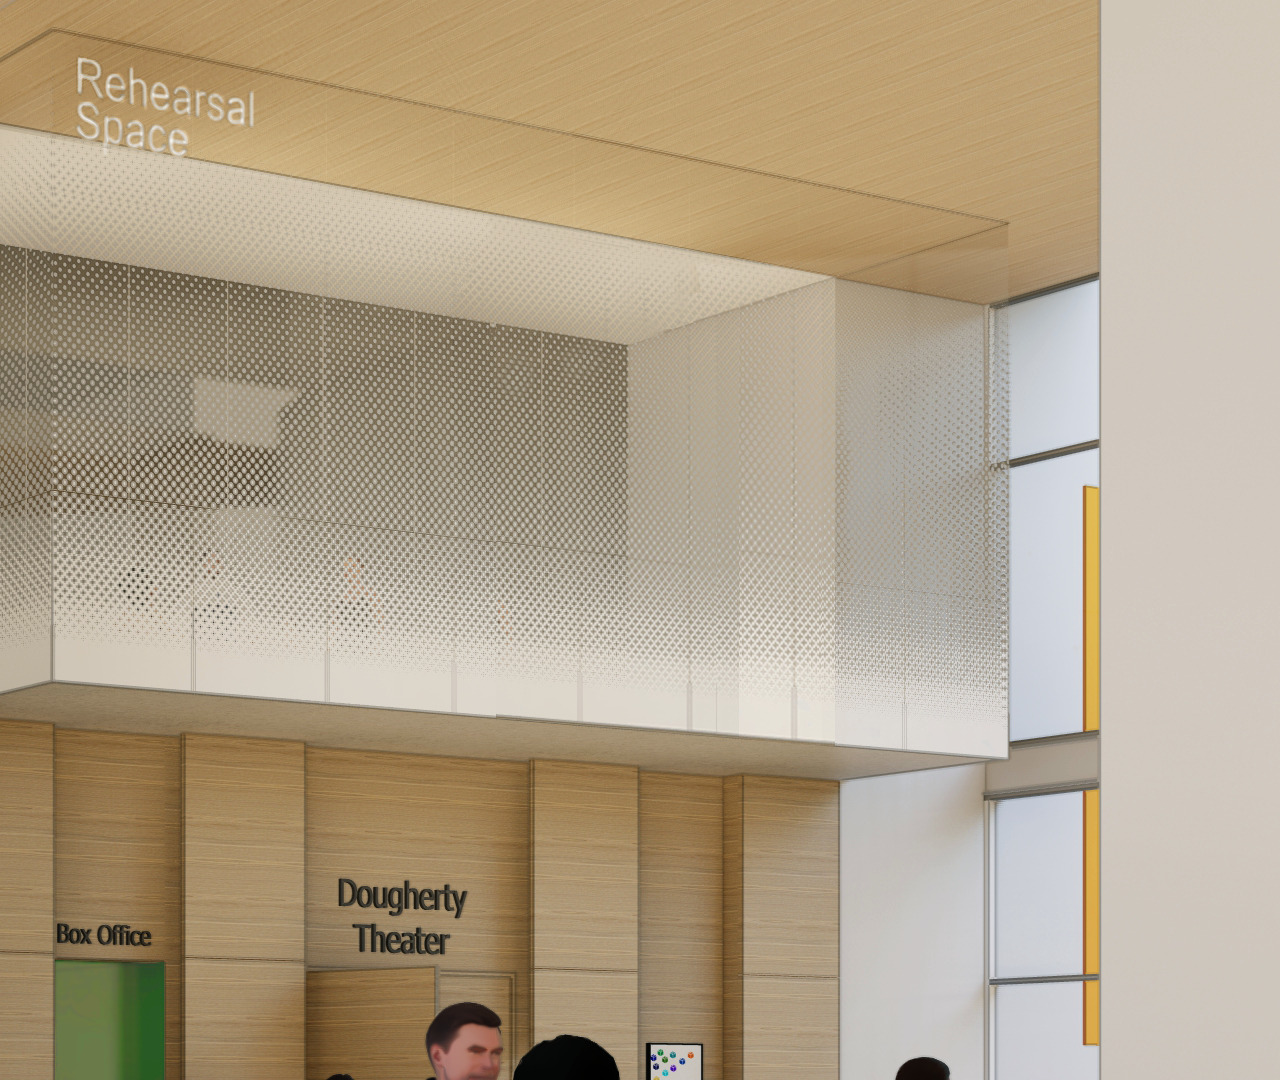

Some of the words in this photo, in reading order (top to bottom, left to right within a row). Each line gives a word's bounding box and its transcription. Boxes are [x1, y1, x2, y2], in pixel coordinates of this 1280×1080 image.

[76, 57, 255, 127] Rehearsal
[76, 101, 189, 156] Space
[338, 878, 468, 919] Dougherty
[56, 923, 92, 945] Box
[96, 924, 153, 947] Office
[352, 923, 451, 955] Theater
